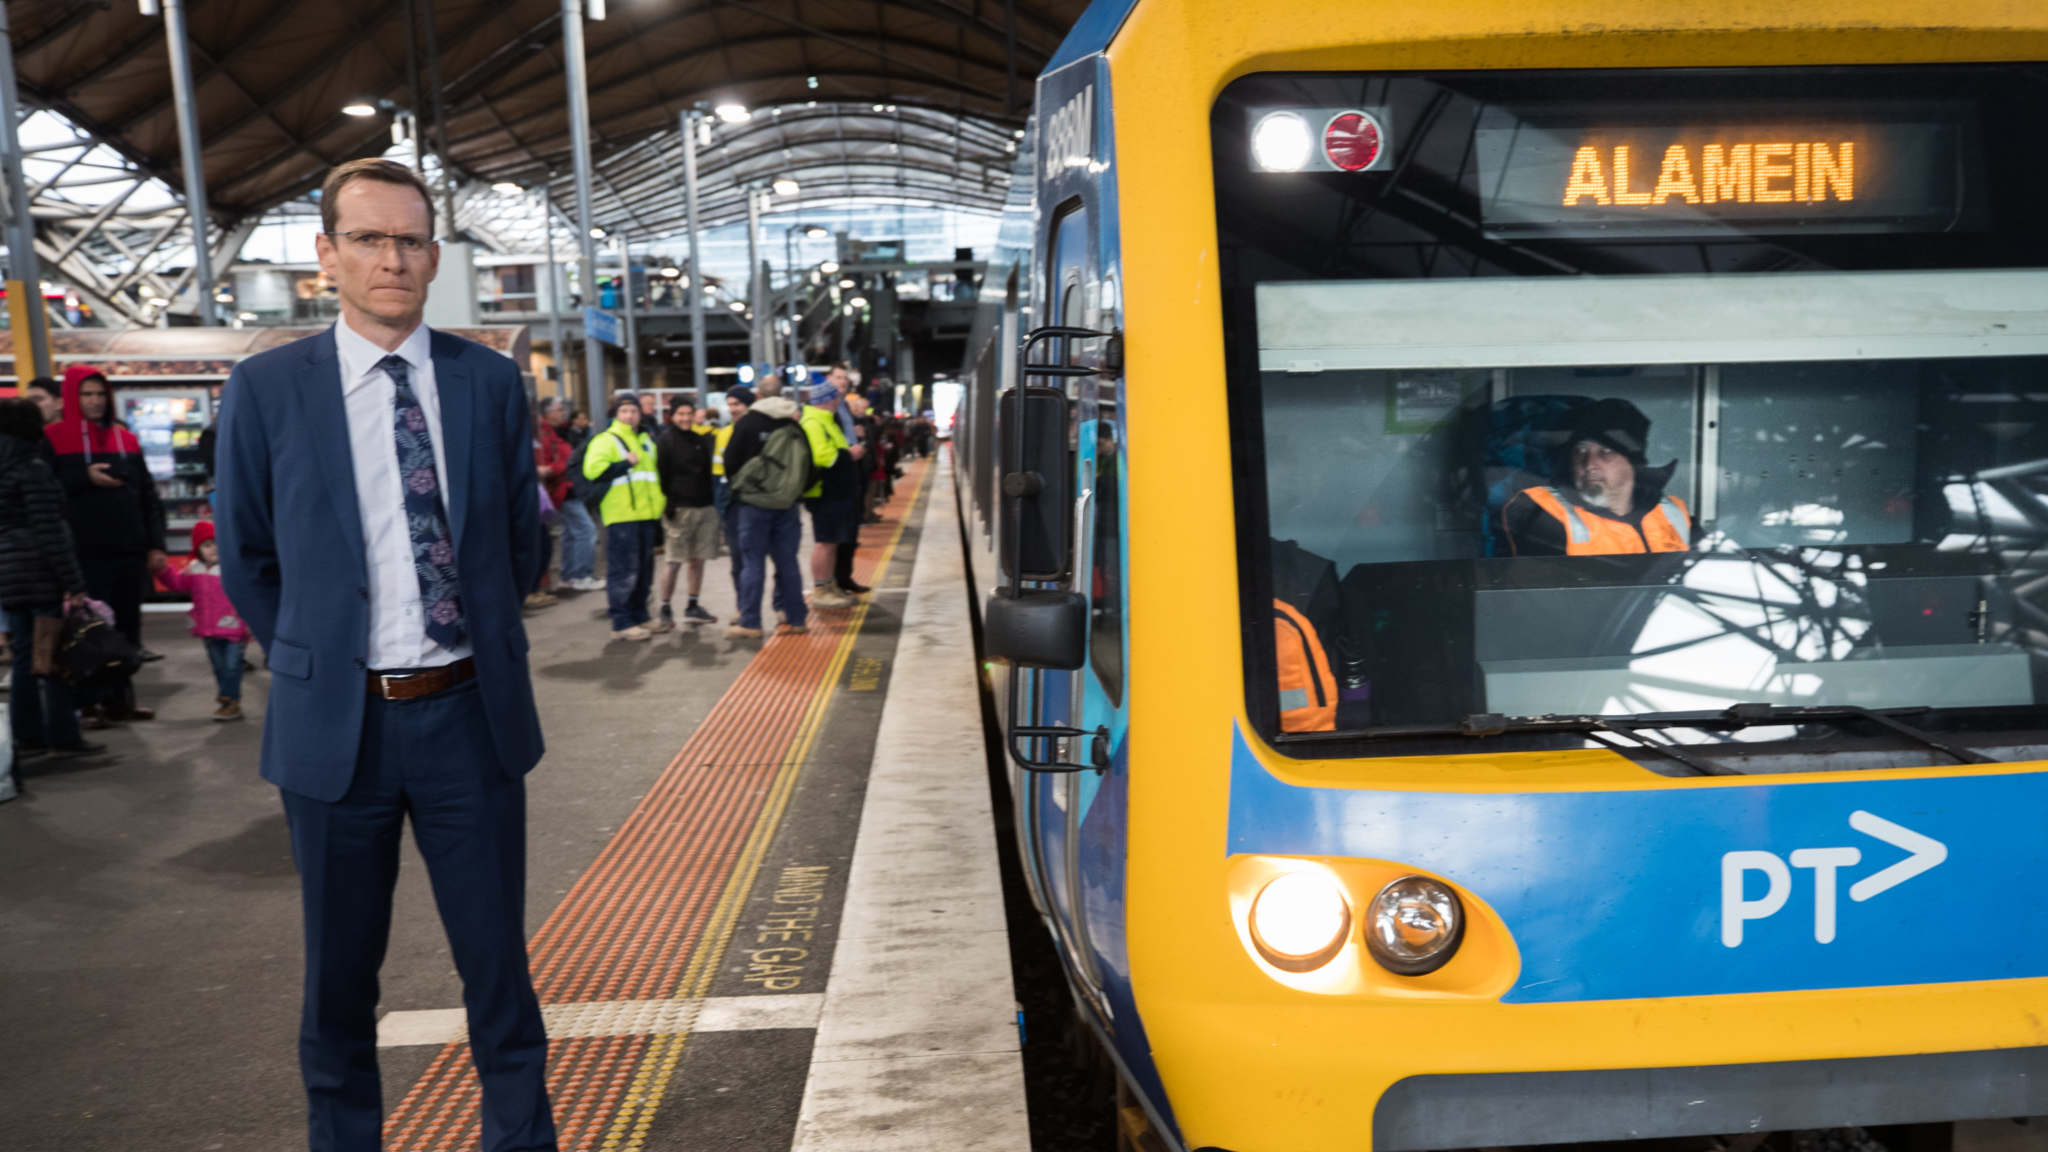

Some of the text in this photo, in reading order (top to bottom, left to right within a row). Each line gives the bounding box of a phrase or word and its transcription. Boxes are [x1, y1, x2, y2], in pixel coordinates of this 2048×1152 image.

[1563, 142, 1854, 206] ALAMEIN
[743, 865, 831, 990] MIND THE GAP
